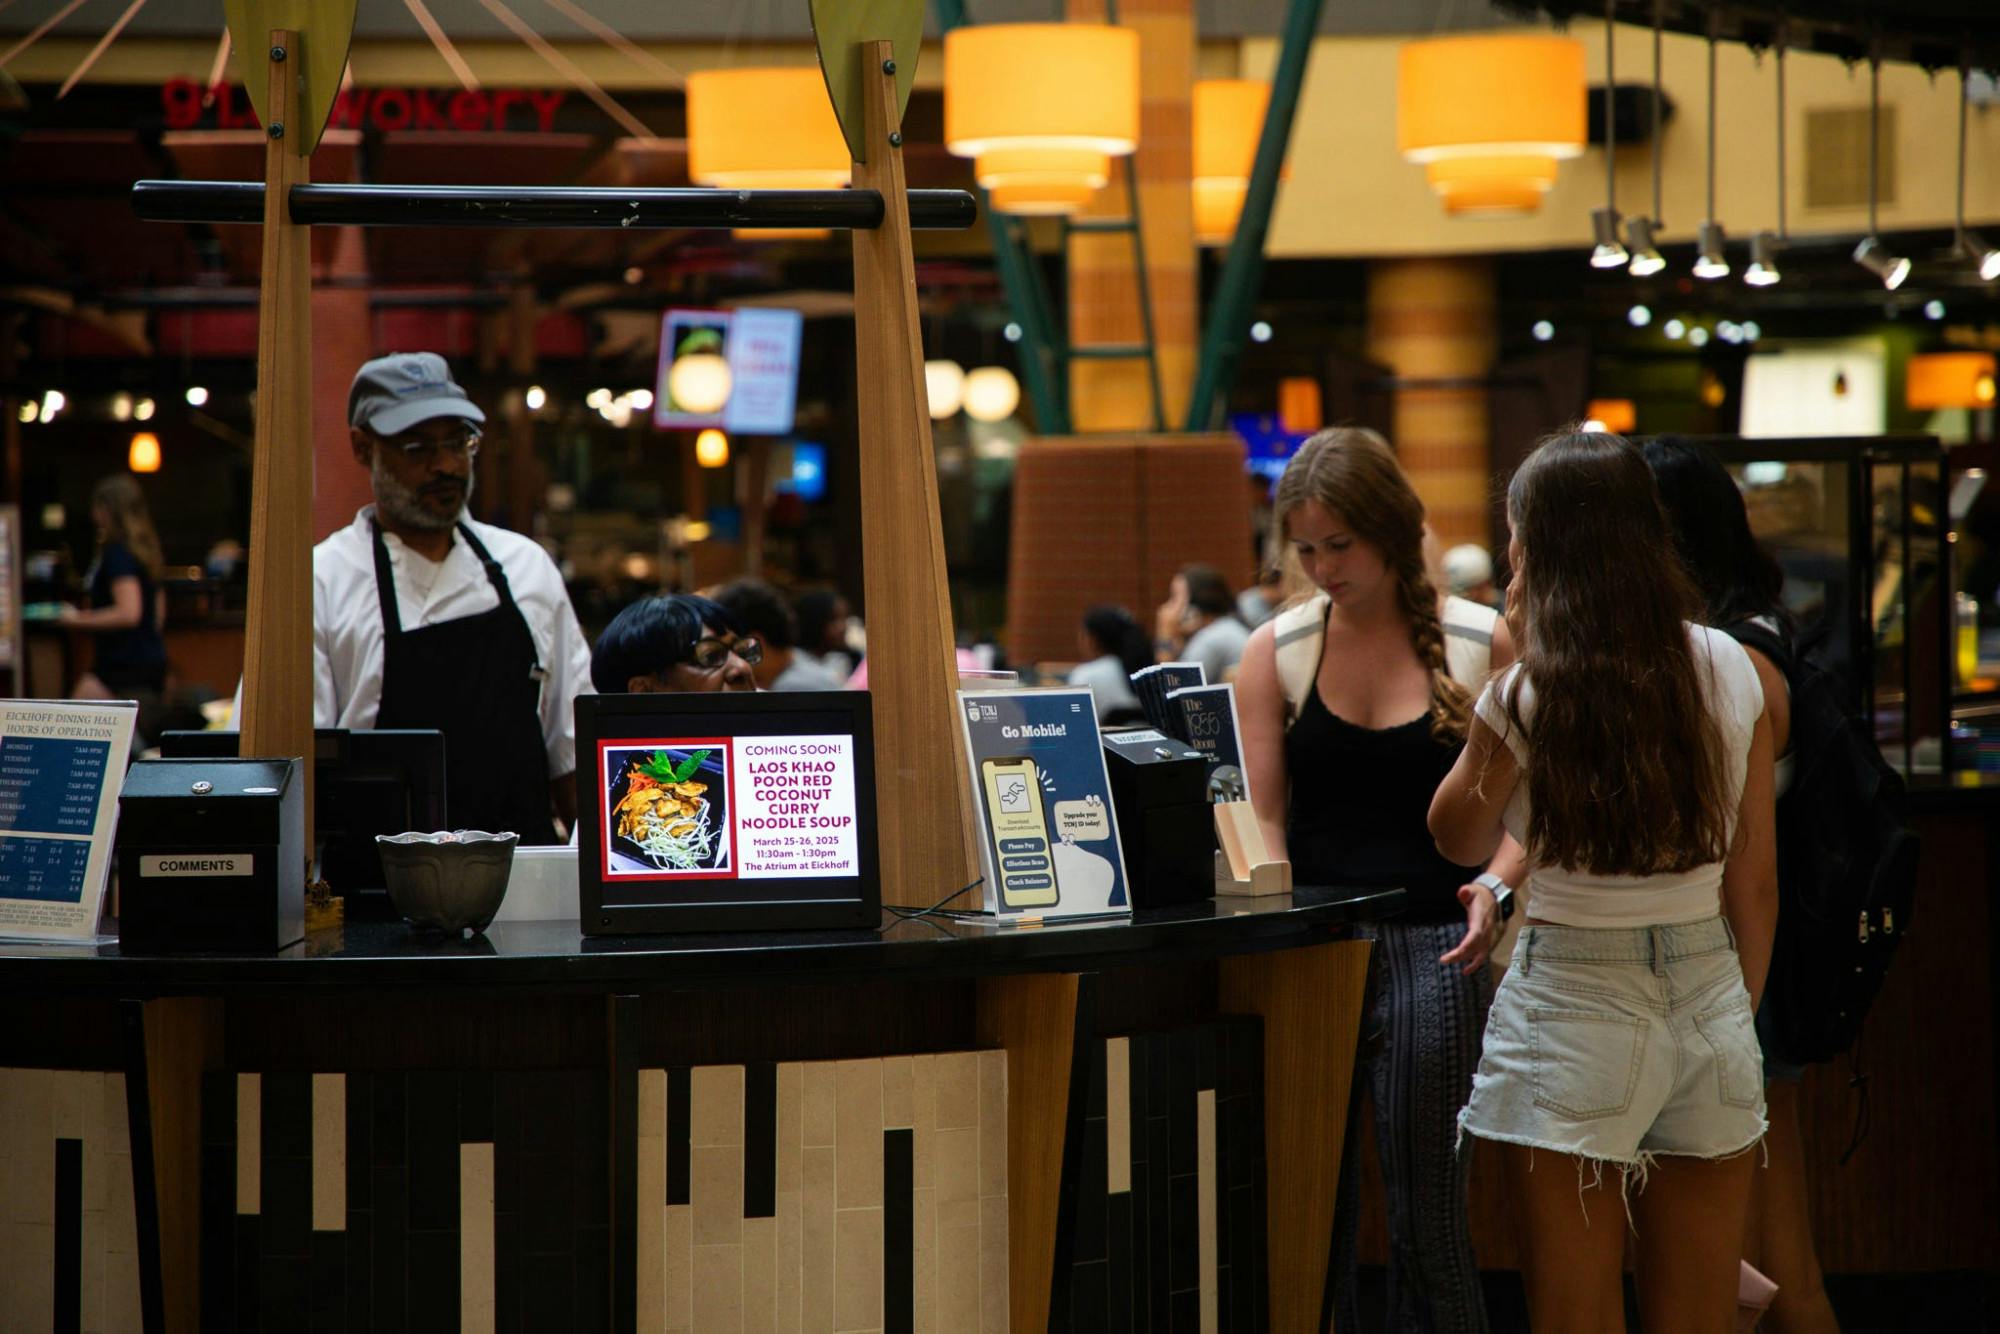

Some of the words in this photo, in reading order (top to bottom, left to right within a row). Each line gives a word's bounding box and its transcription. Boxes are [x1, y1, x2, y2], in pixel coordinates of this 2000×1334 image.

[5, 711, 54, 722] EICKHOFF
[56, 713, 91, 724] DINING
[93, 716, 119, 725] HALL
[6, 724, 39, 735] HOURS
[42, 726, 55, 736] OF
[57, 727, 112, 737] OPERATION
[1002, 725, 1019, 738] Go
[1020, 723, 1067, 737] Mobile!
[745, 745, 797, 756] COMING
[800, 744, 842, 755] SOON!
[749, 762, 788, 774] LAOS
[792, 761, 836, 773] KHAO
[754, 776, 799, 787] POON
[803, 775, 832, 786] RED
[755, 789, 832, 801] COCONUT
[769, 803, 819, 815] CURRY
[742, 817, 807, 829] NOODLE
[810, 816, 851, 828] SOUP
[753, 837, 781, 846] March
[784, 837, 813, 846] 25-26,
[816, 836, 839, 845] 2025
[757, 850, 794, 858] 11:30am
[802, 849, 836, 858] 1:30pm
[159, 861, 234, 871] COMMENTS
[745, 862, 762, 871] The
[765, 862, 797, 870] Atrium
[811, 860, 849, 869] Eickhoff
